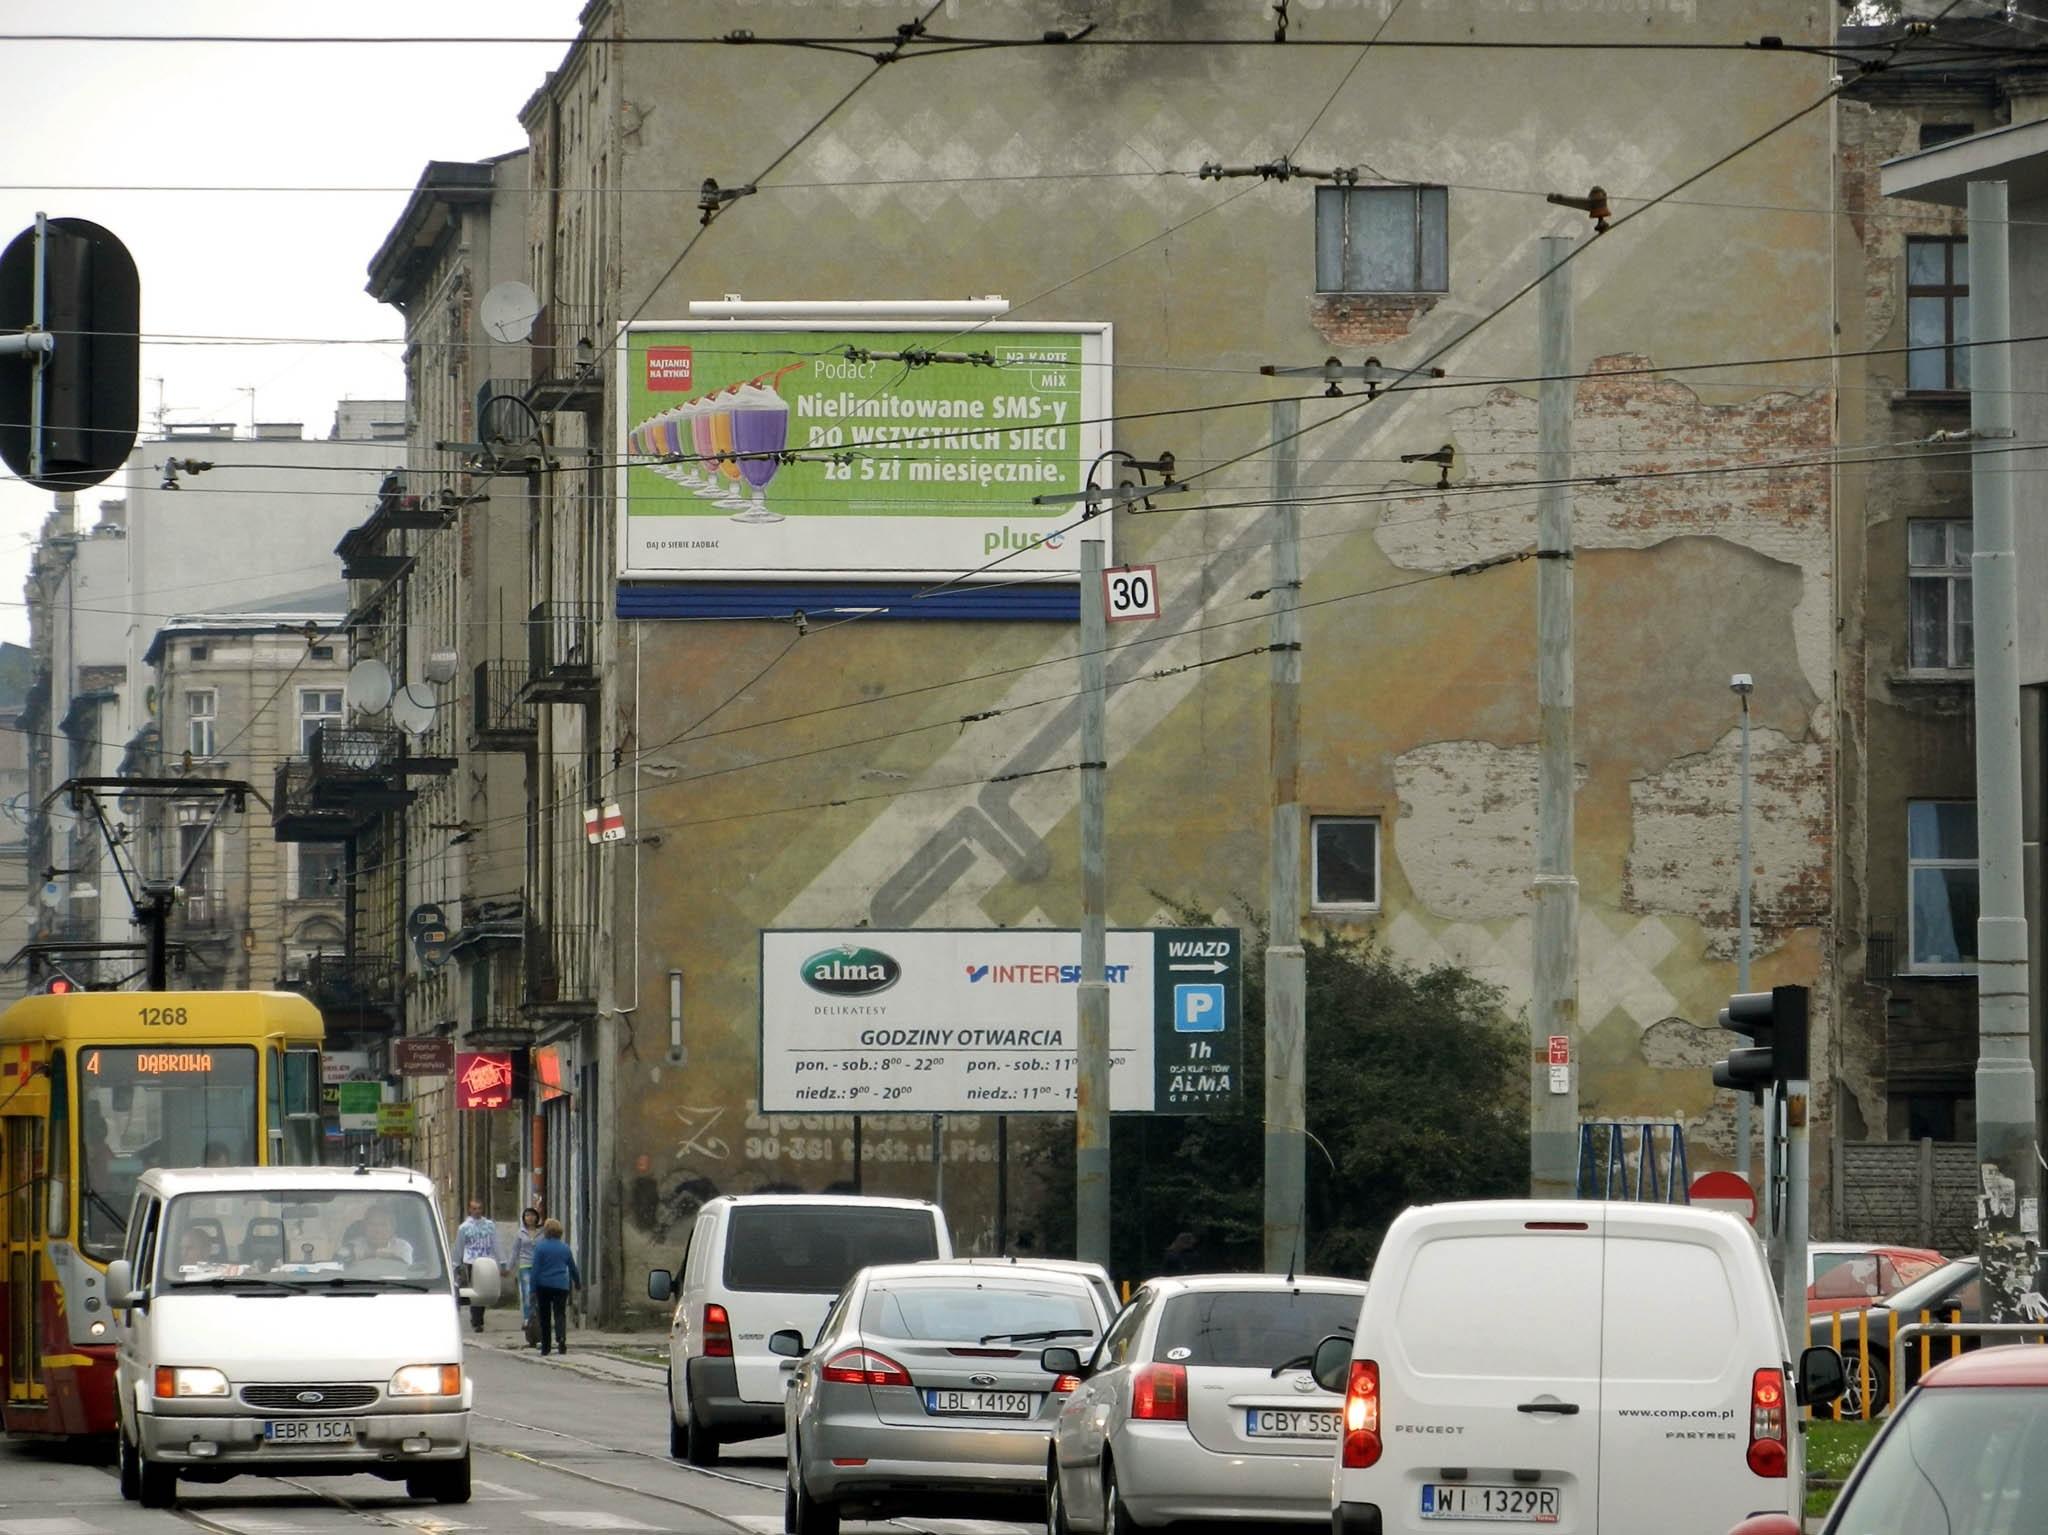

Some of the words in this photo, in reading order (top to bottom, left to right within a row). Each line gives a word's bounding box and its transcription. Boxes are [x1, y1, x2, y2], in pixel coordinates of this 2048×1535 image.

[649, 359, 690, 369] NAJTANIEJ
[649, 369, 661, 378] NA
[663, 369, 690, 378] RYNKU
[797, 391, 984, 418] Nielimitowane
[992, 396, 1067, 424] SMS-y
[809, 425, 843, 449] DO
[852, 425, 1001, 450] WSZYSTKICH
[1009, 428, 1066, 450] SIECI
[824, 461, 851, 481] za
[861, 457, 874, 481] 5
[879, 455, 900, 481] zł
[909, 457, 1066, 487] miesięcznie.
[646, 541, 659, 550] DAJ
[661, 541, 666, 549] O
[668, 541, 689, 549] SIEBIE
[692, 540, 720, 549] ZADBAĆ
[984, 526, 1042, 555] plus
[1112, 577, 1150, 611] 30
[1168, 941, 1231, 958] WJAZD
[814, 960, 887, 981] alma
[814, 1006, 887, 1016] DELIKATESY
[1187, 993, 1213, 1022] P
[138, 1007, 188, 1026] 1268
[860, 1029, 953, 1046] GODZINY
[958, 1029, 1063, 1046] OTWARCIA
[1189, 1041, 1211, 1059] 1h
[86, 1052, 99, 1075] 4
[137, 1053, 212, 1074] DĄBROWA
[795, 1060, 828, 1074] pon.
[842, 1058, 878, 1071] sob.:
[966, 1060, 1000, 1073] pon.
[1013, 1058, 1050, 1071] sob.:
[1169, 1075, 1231, 1092] ALMA
[795, 1086, 846, 1100] niedz.:
[967, 1086, 1017, 1100] niedz.:
[938, 1393, 969, 1410] LBL
[977, 1393, 1026, 1411] 14196
[1260, 1412, 1301, 1432] CBY
[1618, 1408, 1734, 1420] www.comp.com.pl
[274, 1422, 308, 1439] EBR
[316, 1421, 353, 1438] 15CA
[1395, 1425, 1465, 1435] PEUGEOT
[1665, 1431, 1736, 1440] PARTNER
[1438, 1489, 1465, 1511] WI
[1483, 1489, 1554, 1514] 1329R
